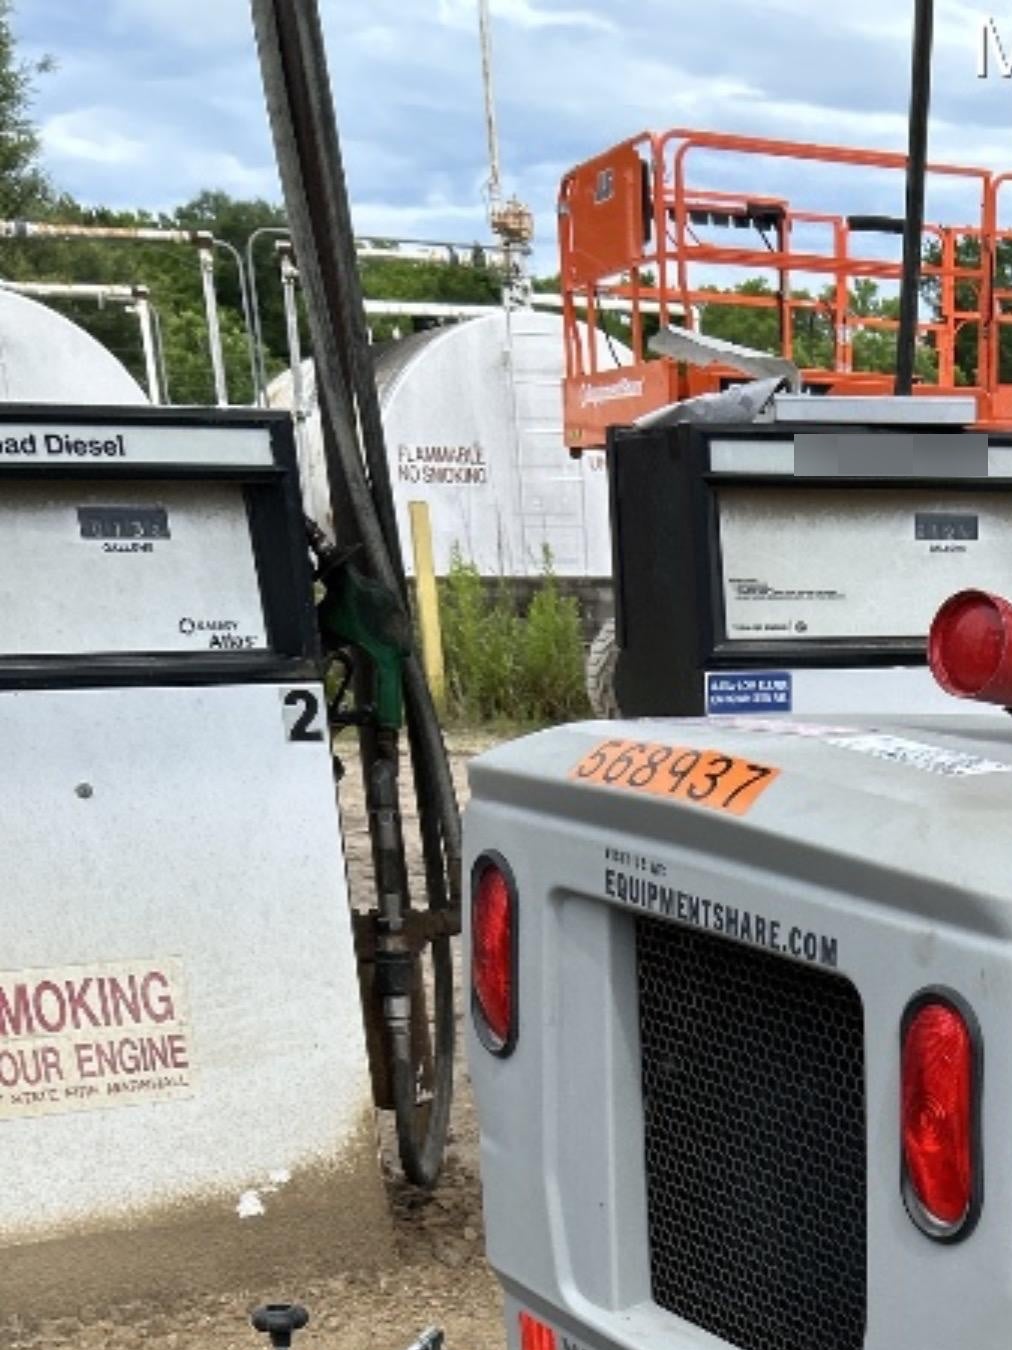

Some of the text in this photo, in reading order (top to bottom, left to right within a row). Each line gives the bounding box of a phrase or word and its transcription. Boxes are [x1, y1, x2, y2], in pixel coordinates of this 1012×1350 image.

[44, 434, 126, 456] Diesel
[399, 464, 487, 484] NO SMOKING
[284, 689, 324, 741] 2
[577, 740, 771, 808] 568937
[604, 867, 838, 968] EQUIPMENTSHARE.COM
[74, 1034, 190, 1079] ENGINE
